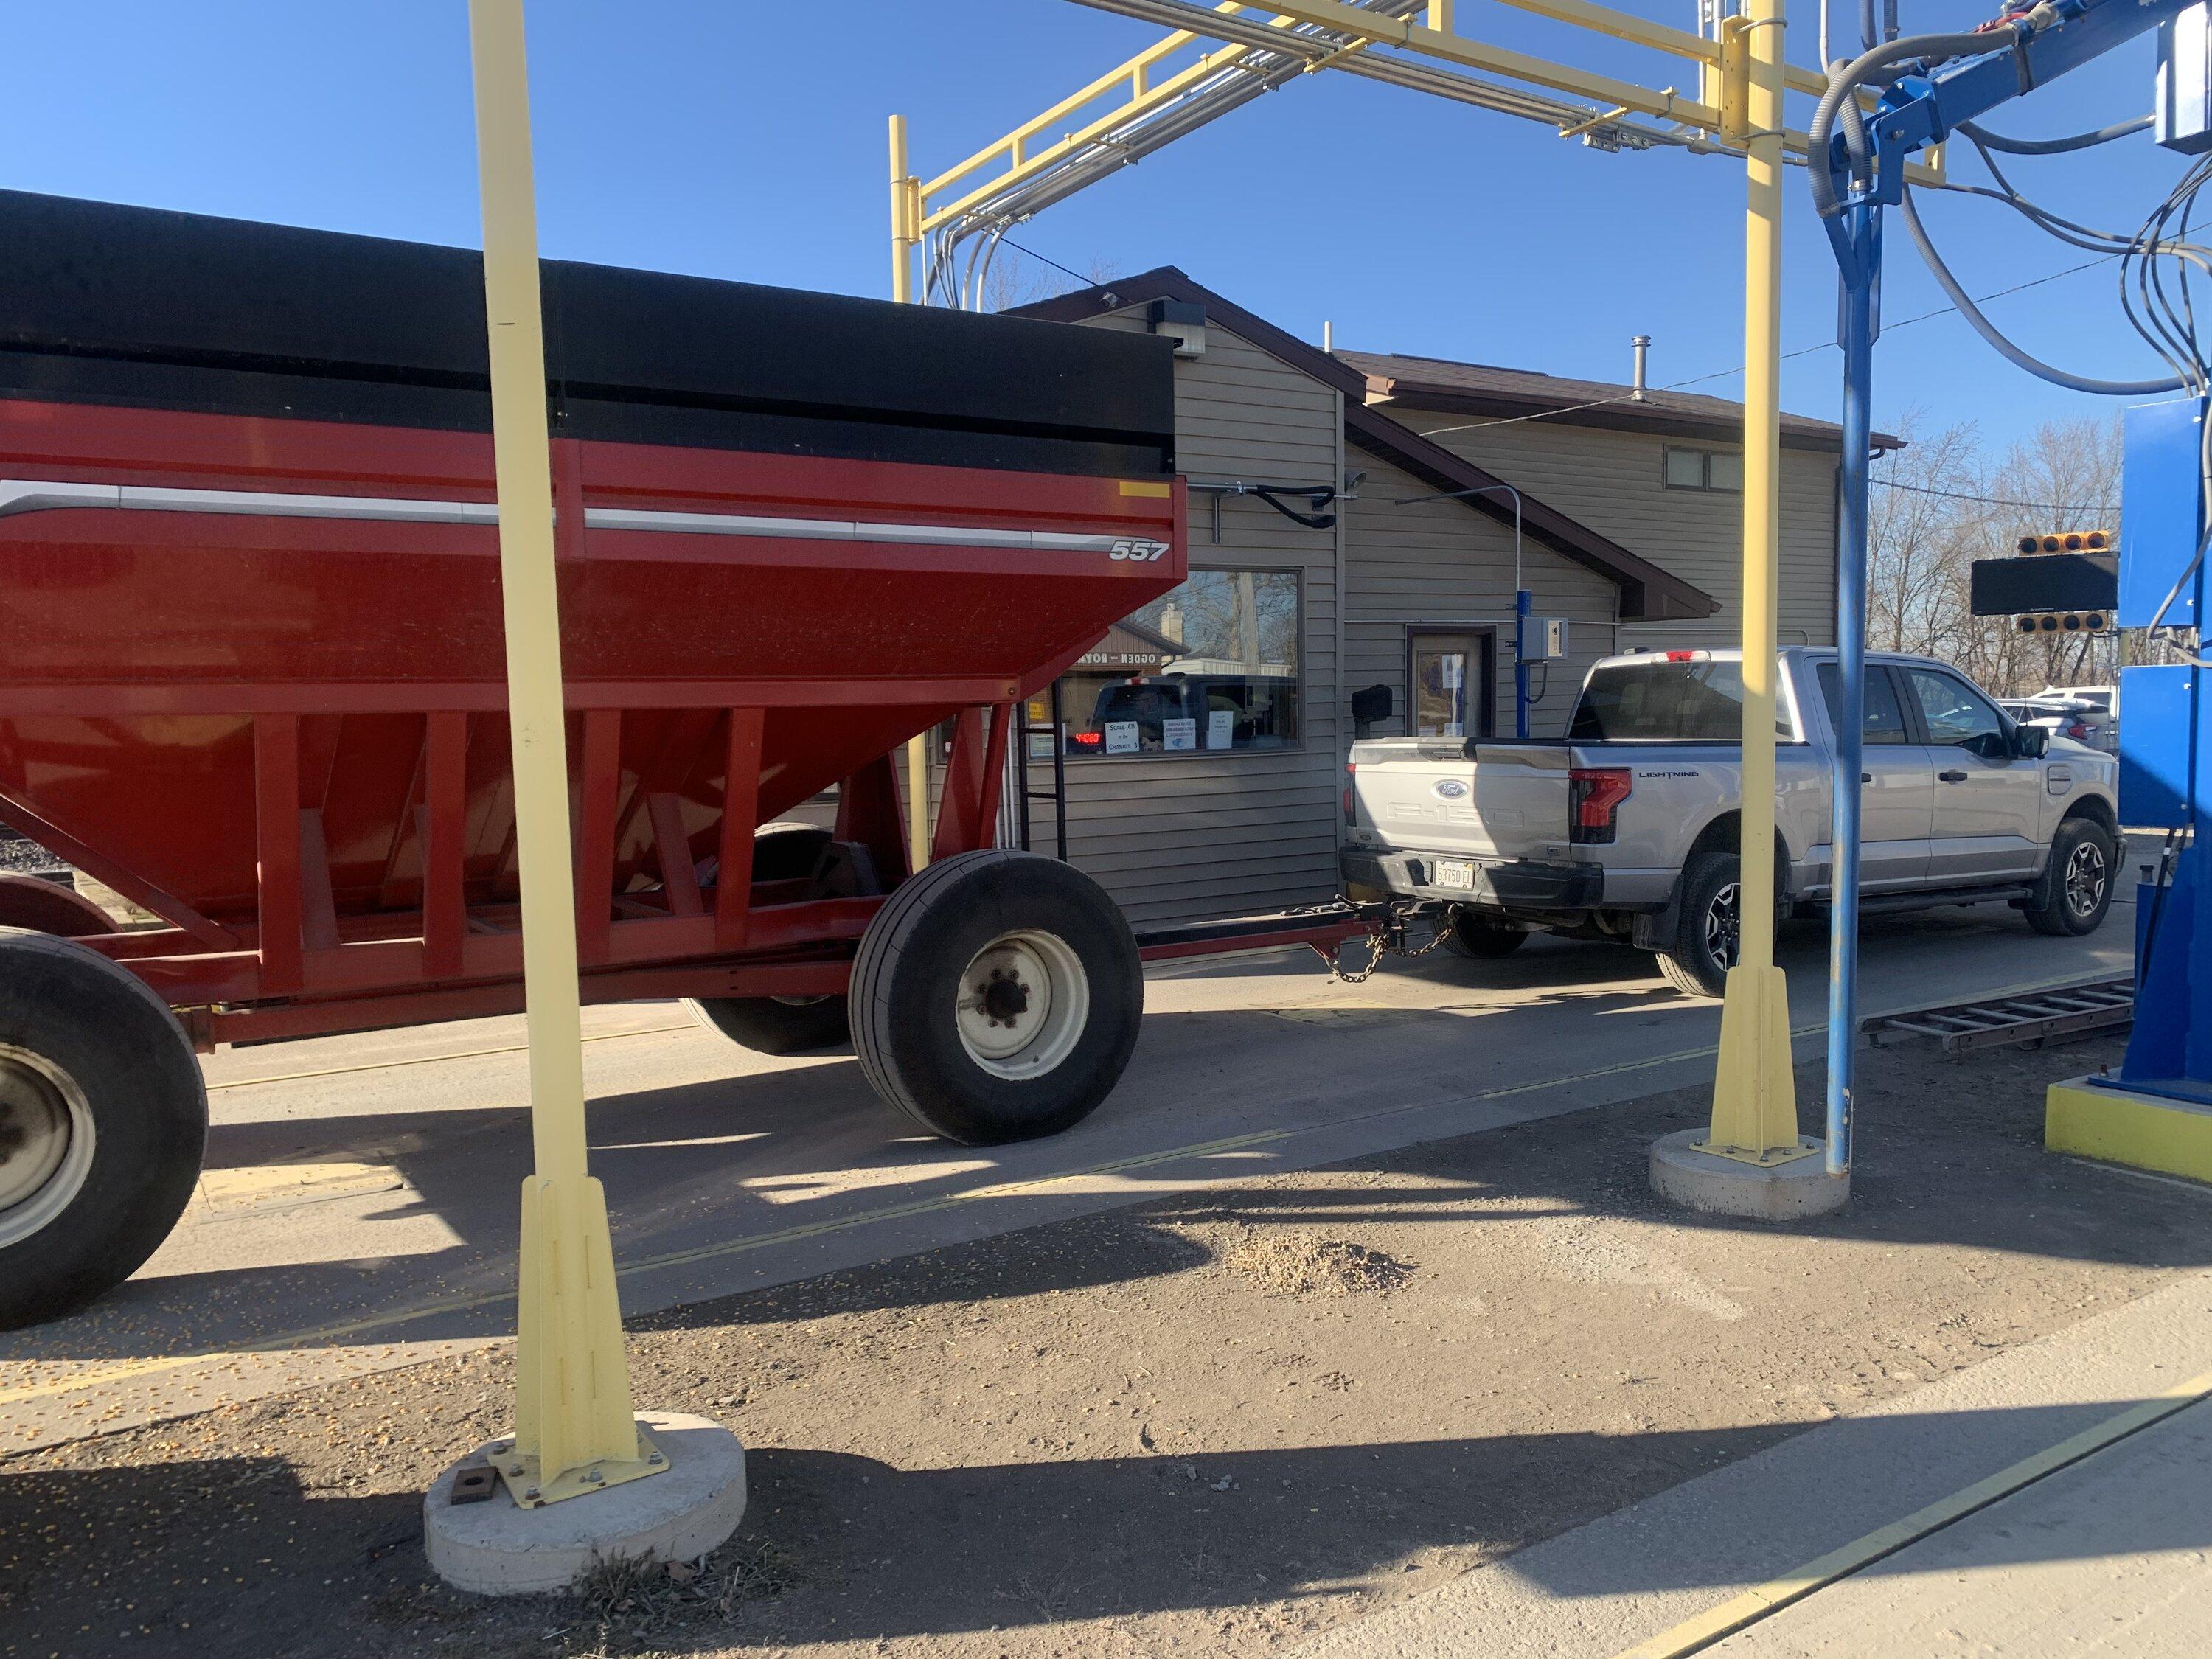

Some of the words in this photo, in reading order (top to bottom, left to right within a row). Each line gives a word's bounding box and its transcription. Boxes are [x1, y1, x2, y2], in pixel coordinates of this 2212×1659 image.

[1108, 540, 1171, 562] 557
[1441, 784, 1460, 796] Ford
[1386, 801, 1525, 827] F-150
[1438, 868, 1461, 883] 53750
[1462, 870, 1472, 884] EL
